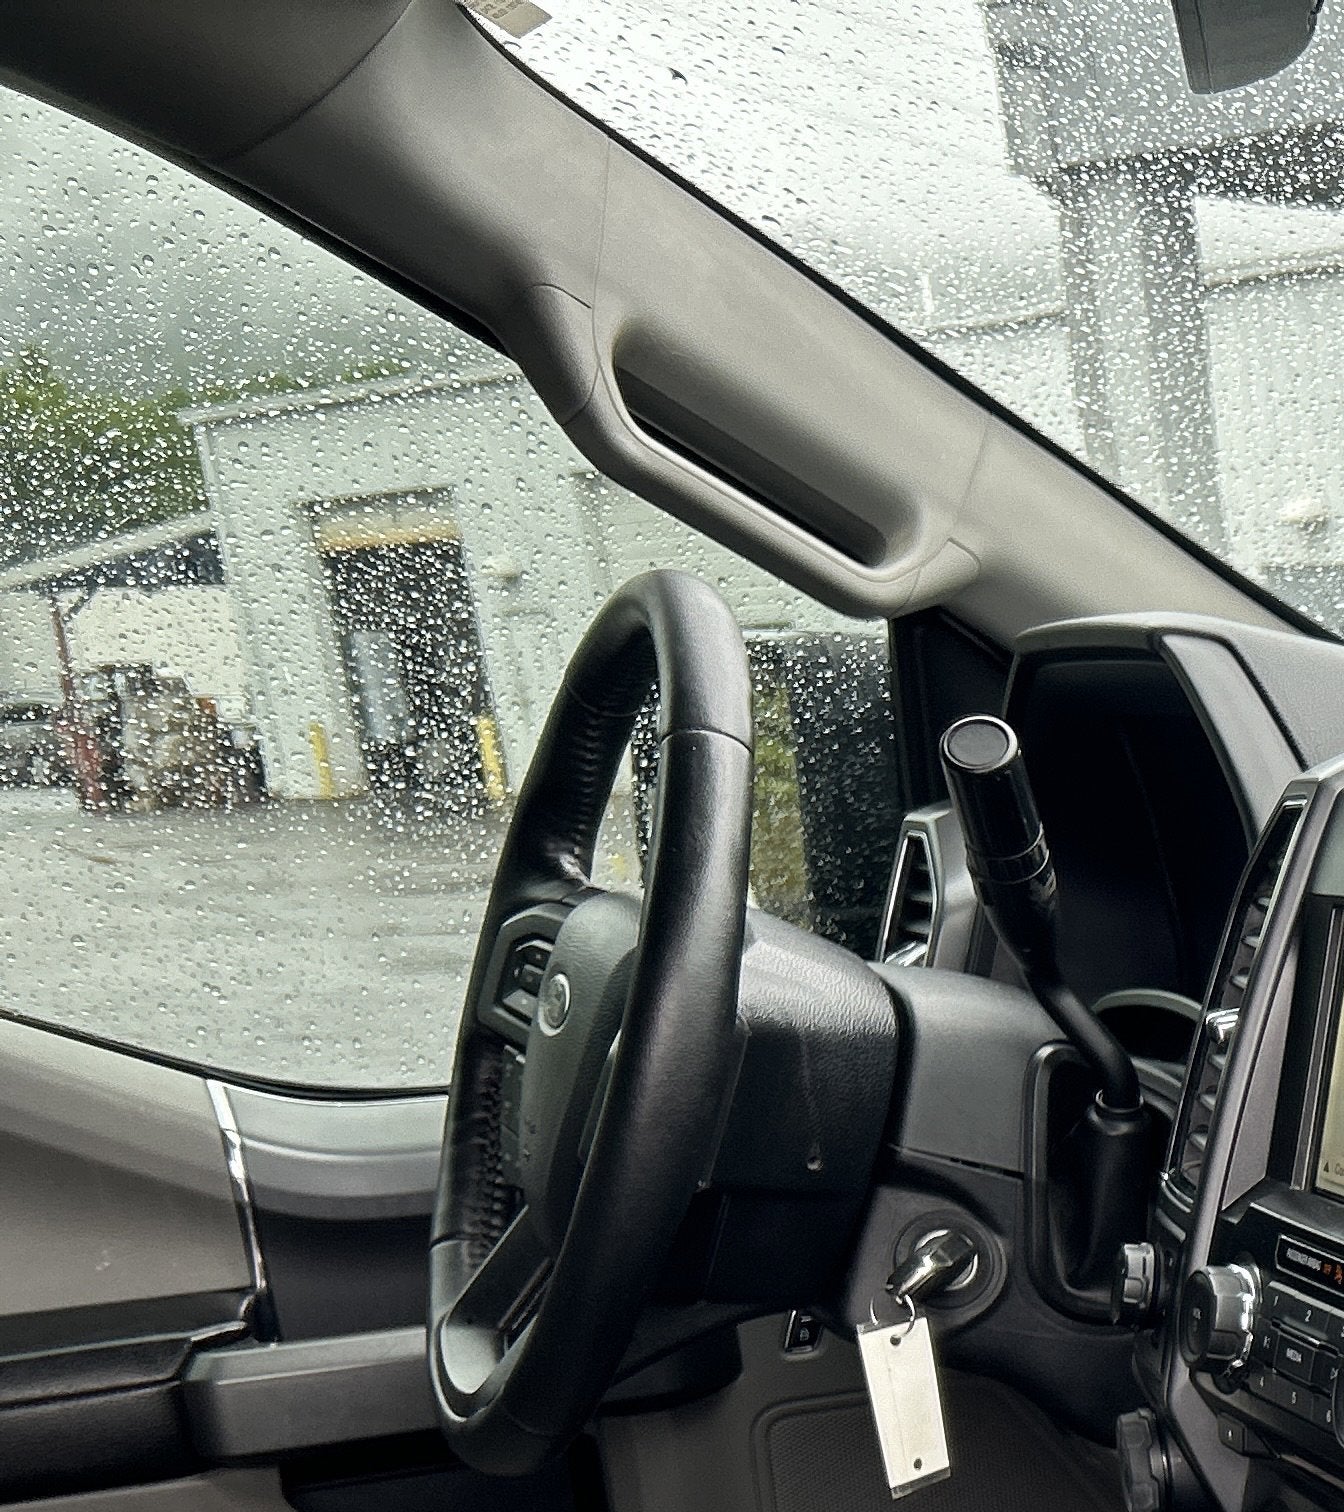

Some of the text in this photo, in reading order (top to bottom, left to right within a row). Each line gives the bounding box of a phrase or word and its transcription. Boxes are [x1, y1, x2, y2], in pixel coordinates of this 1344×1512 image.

[1304, 1309, 1312, 1322] 2
[1290, 1391, 1297, 1404] 5
[1325, 1409, 1332, 1423] 6
